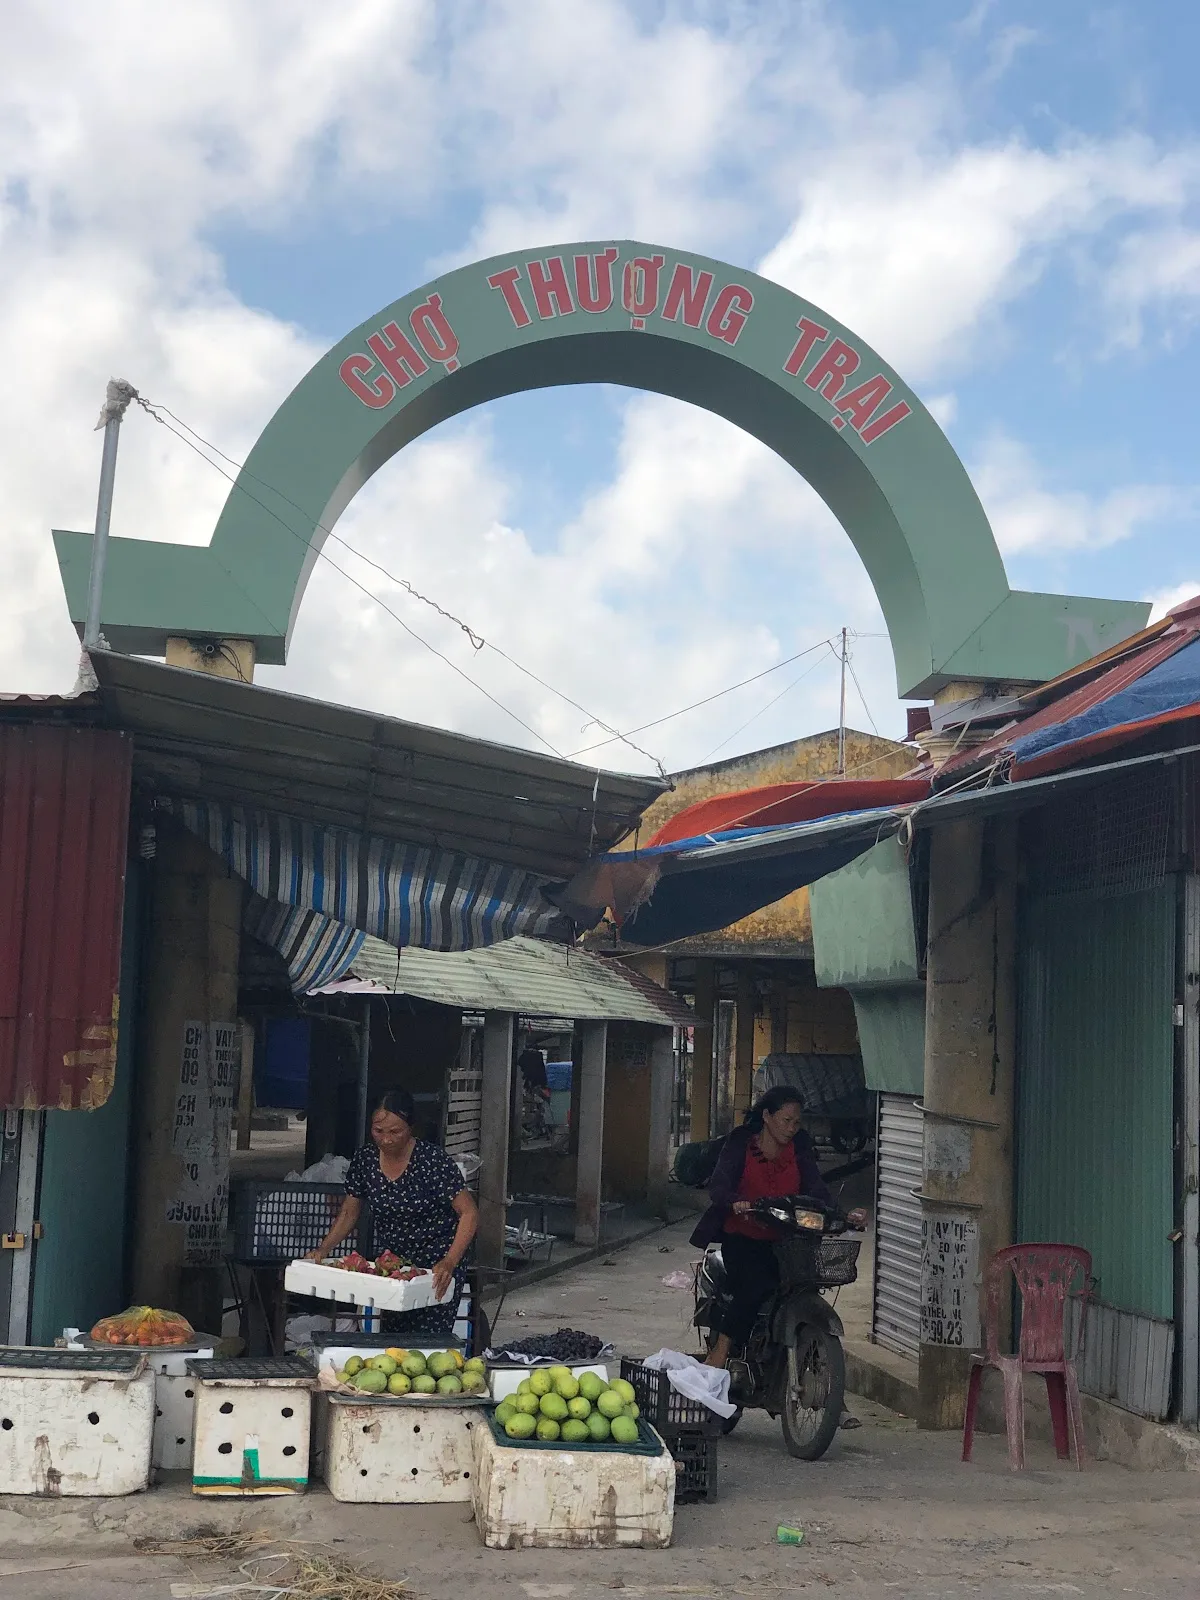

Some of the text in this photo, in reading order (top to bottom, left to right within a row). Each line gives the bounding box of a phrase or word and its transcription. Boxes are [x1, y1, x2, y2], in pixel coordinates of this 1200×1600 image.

[338, 247, 913, 446] CHỢ THƯỢNG TRẠI
